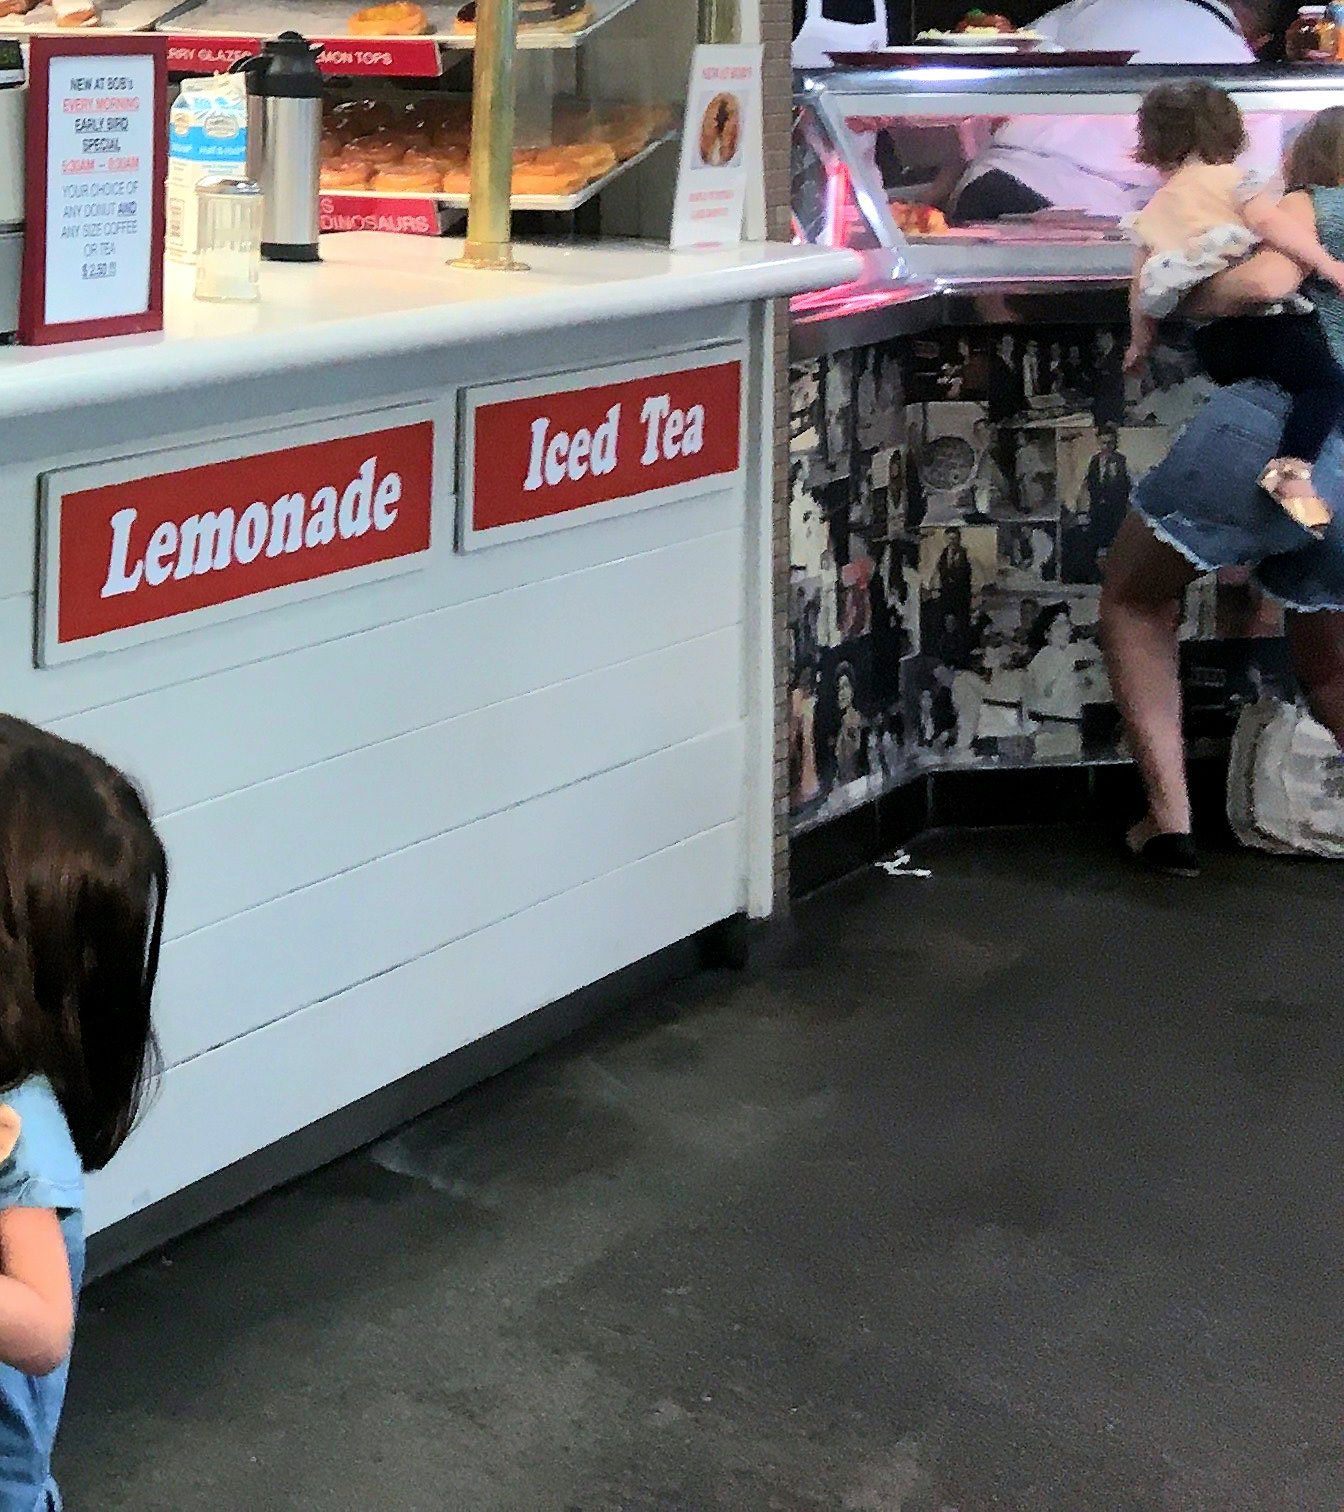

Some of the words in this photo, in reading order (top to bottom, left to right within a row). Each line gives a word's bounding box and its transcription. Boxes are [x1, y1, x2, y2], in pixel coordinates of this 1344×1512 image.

[354, 51, 393, 65] TOPS
[522, 403, 622, 493] Iced
[638, 392, 709, 469] Tea
[99, 453, 404, 599] Lemonade
